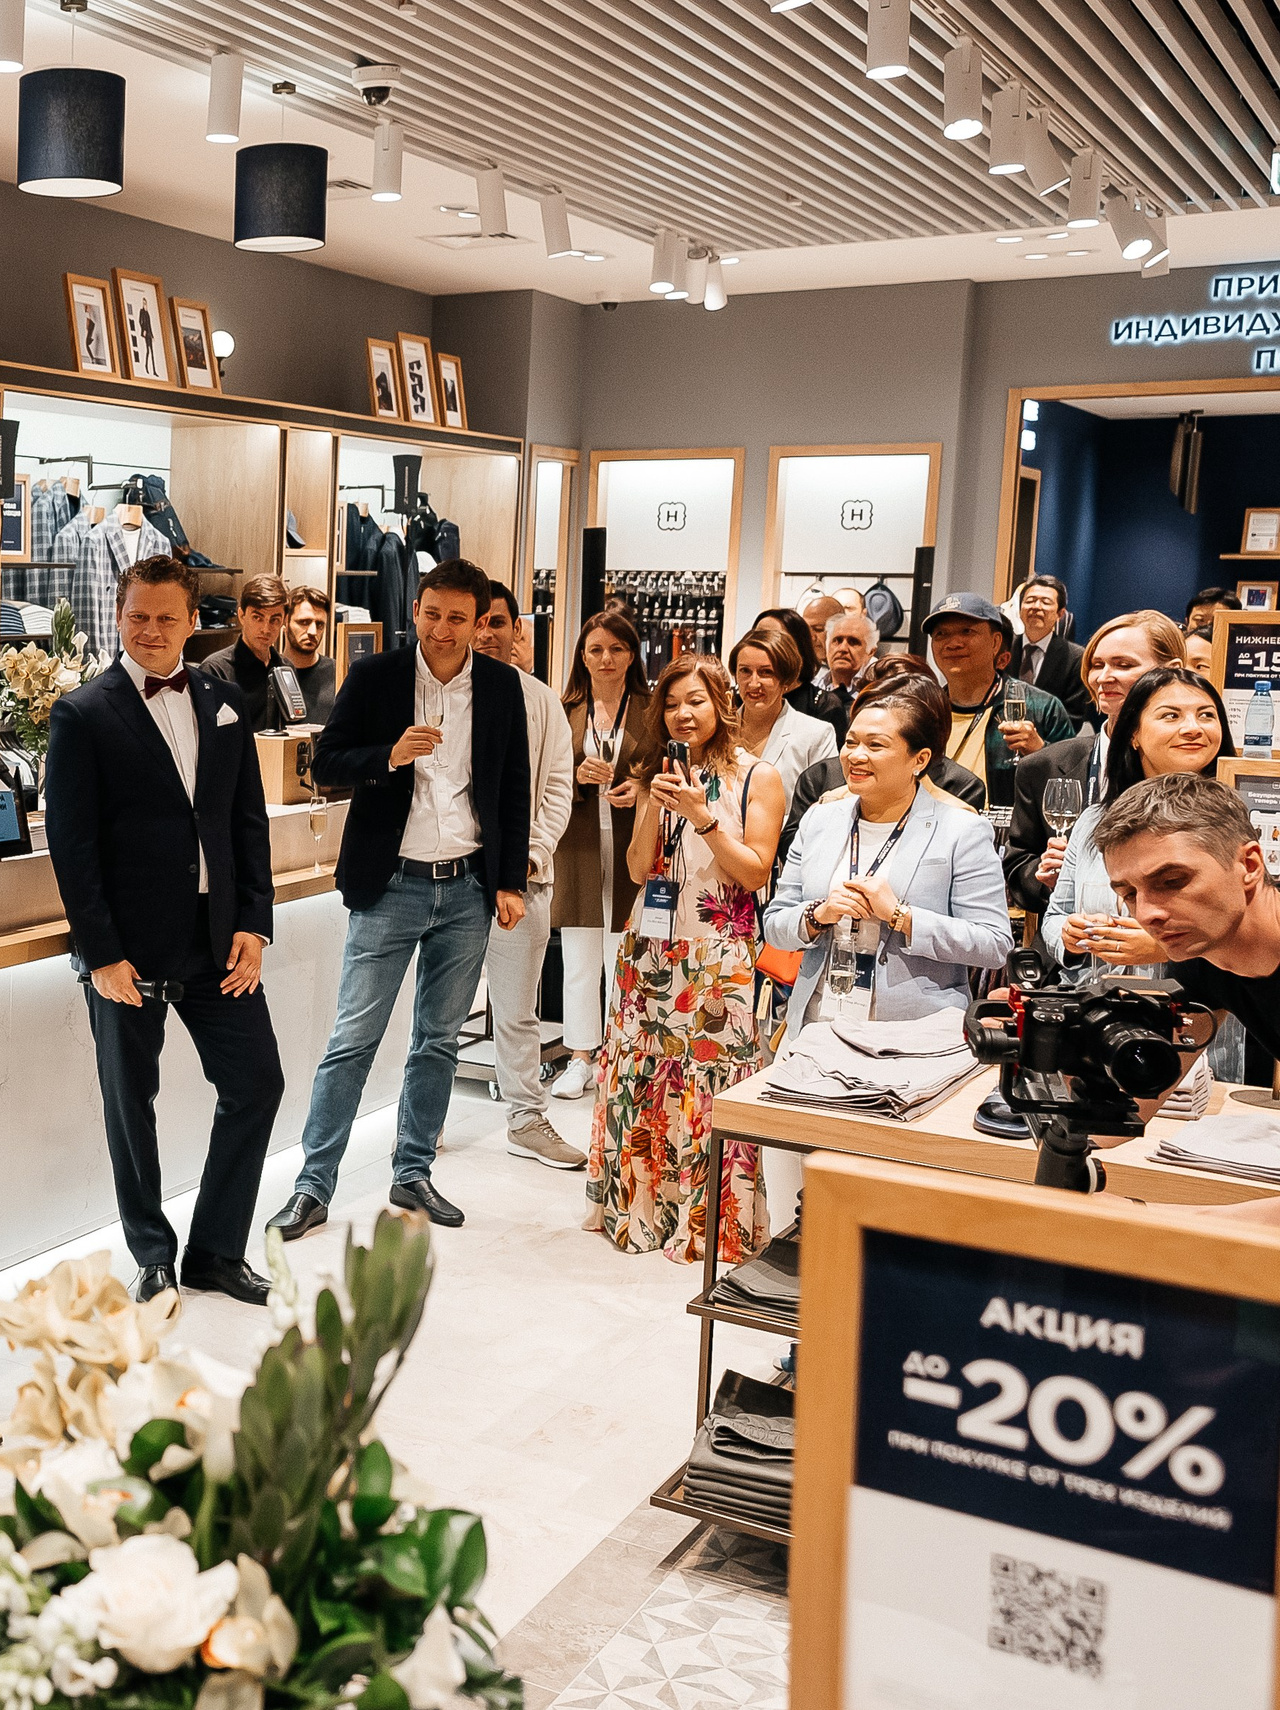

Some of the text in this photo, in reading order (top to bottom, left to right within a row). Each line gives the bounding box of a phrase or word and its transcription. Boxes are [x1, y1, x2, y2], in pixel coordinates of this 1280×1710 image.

[1213, 273, 1280, 298] ПРИ
[666, 510, 678, 522] H
[850, 508, 864, 521] H
[980, 1297, 1146, 1360] АКЦИЯ
[902, 1350, 950, 1379] ДО
